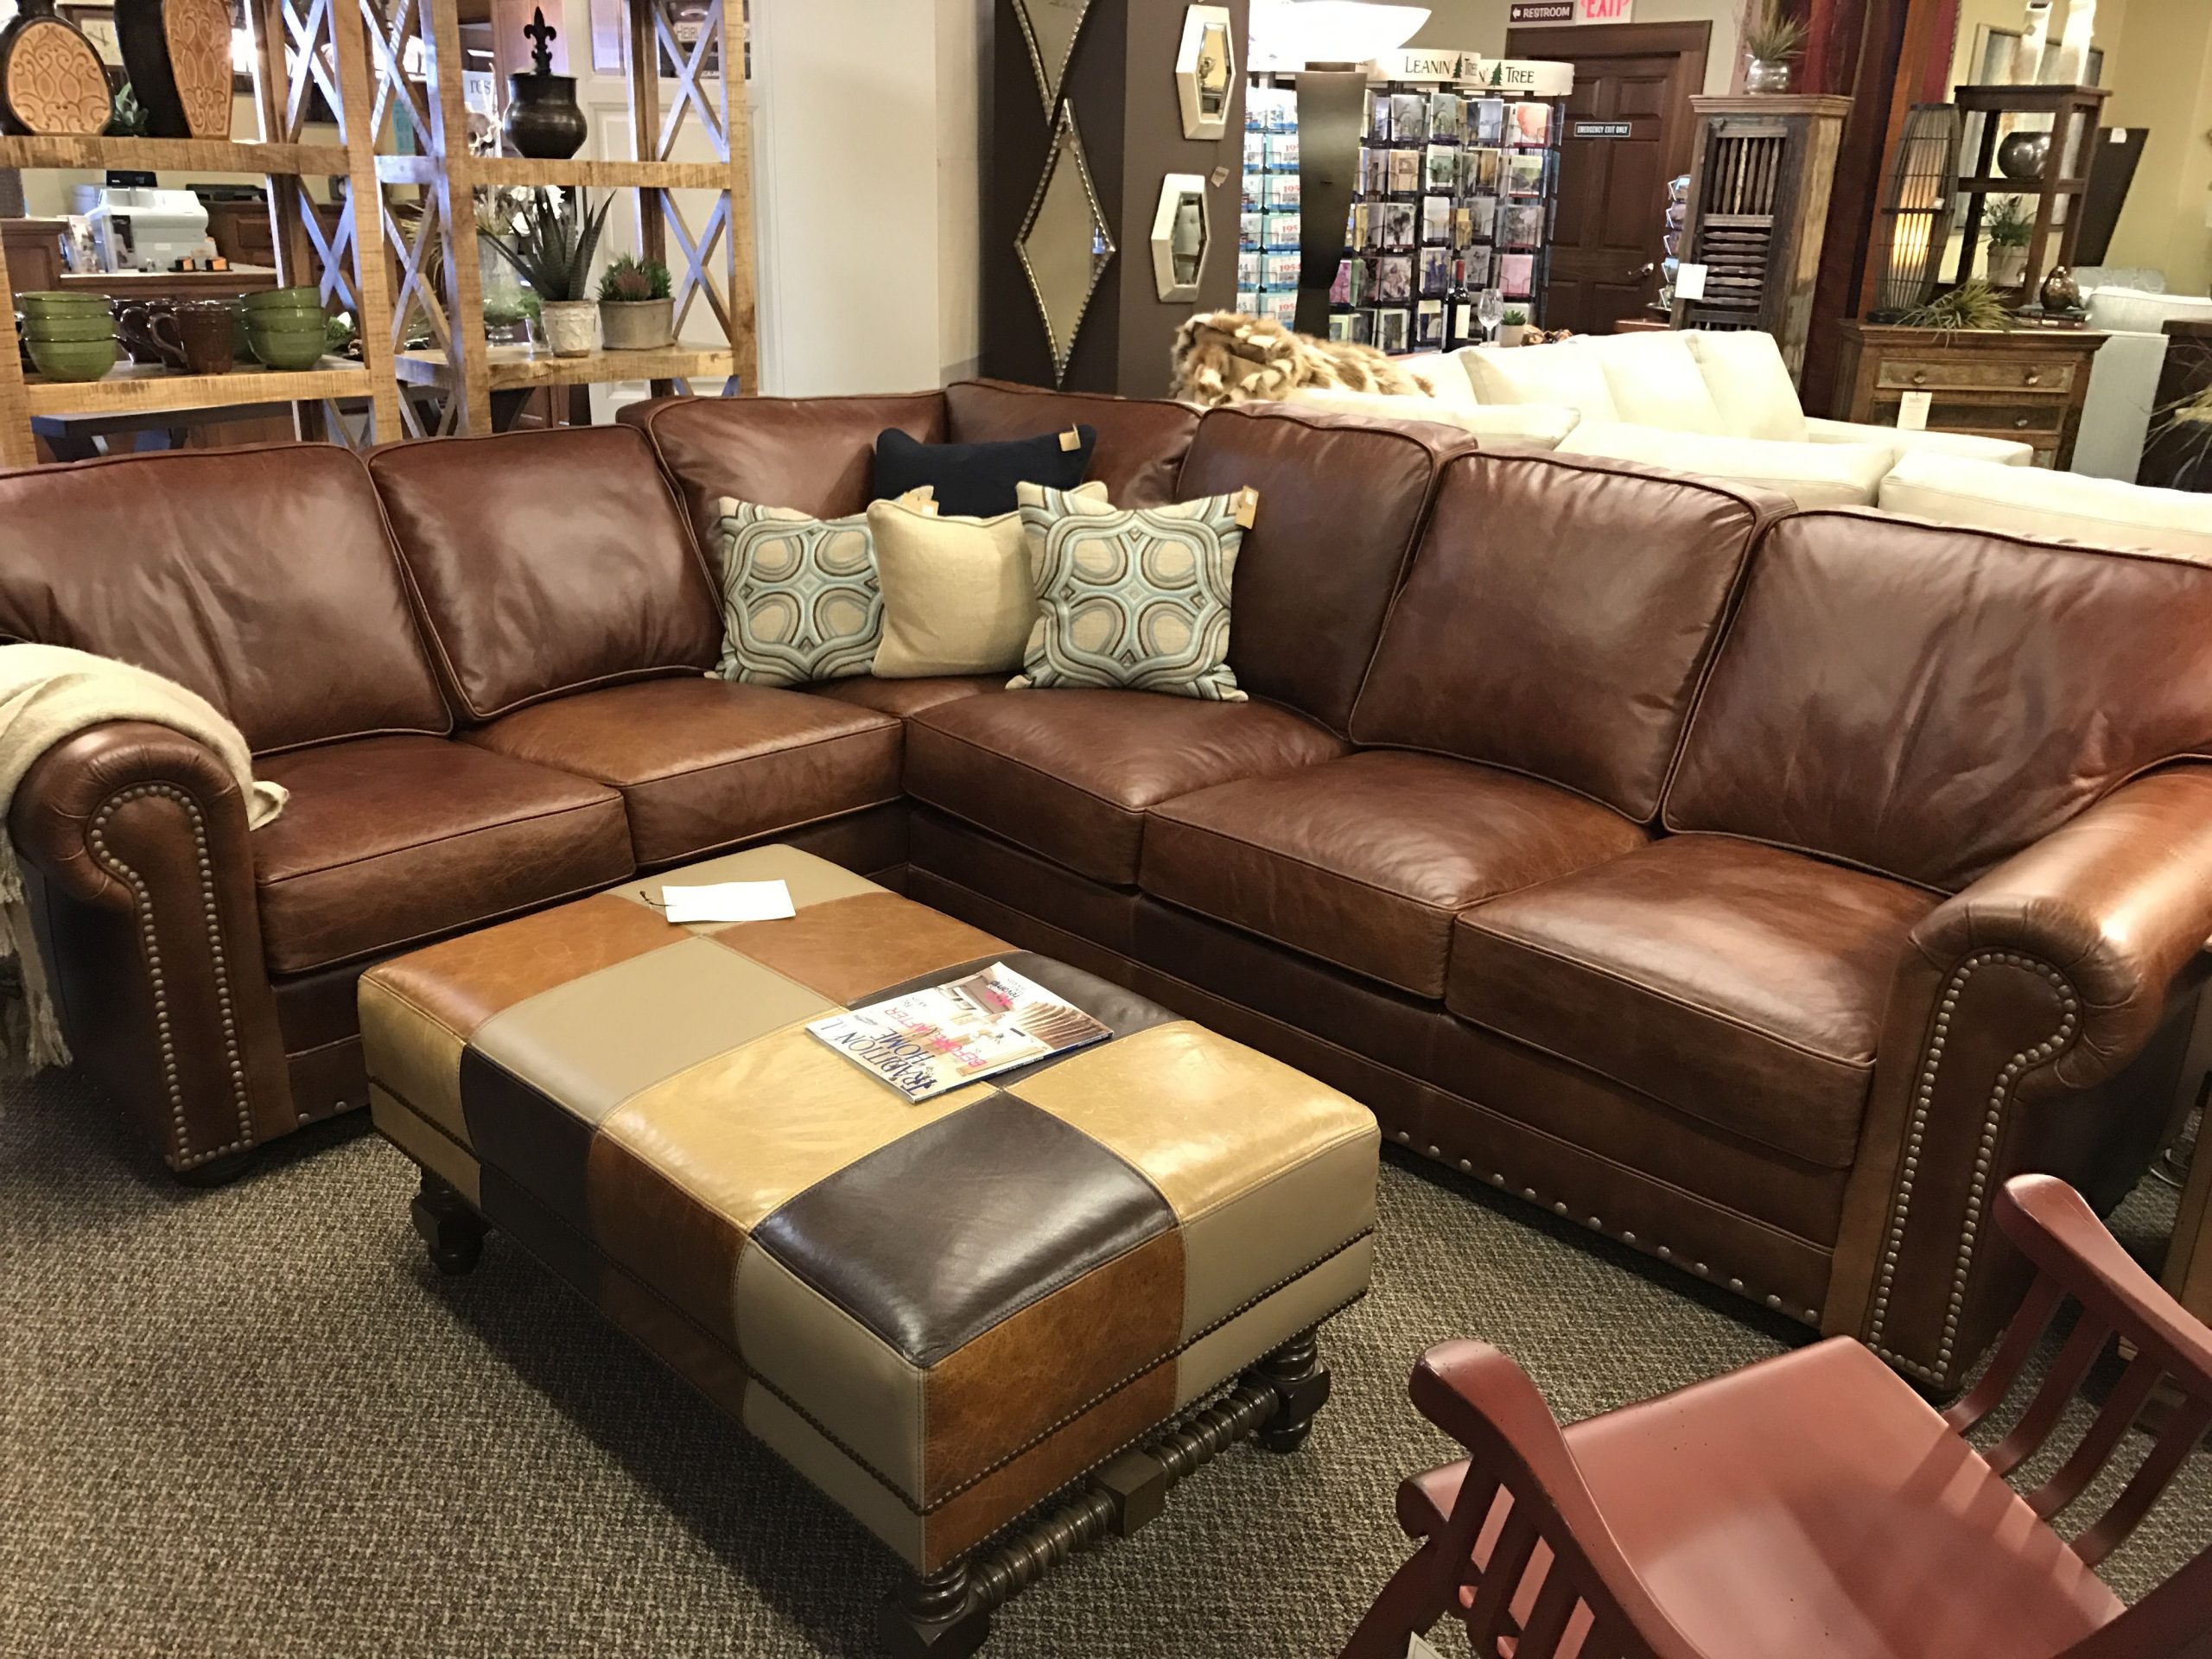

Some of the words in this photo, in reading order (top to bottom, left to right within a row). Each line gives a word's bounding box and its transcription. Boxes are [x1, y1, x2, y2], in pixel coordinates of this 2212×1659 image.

[1522, 6, 1570, 18] RESTROOM
[1586, 0, 1622, 18] EXIT
[1405, 56, 1453, 75] LEANIN'
[1505, 66, 1535, 84] TREE
[869, 1027, 935, 1065] HOME
[821, 1019, 938, 1096] TRADITIONL
